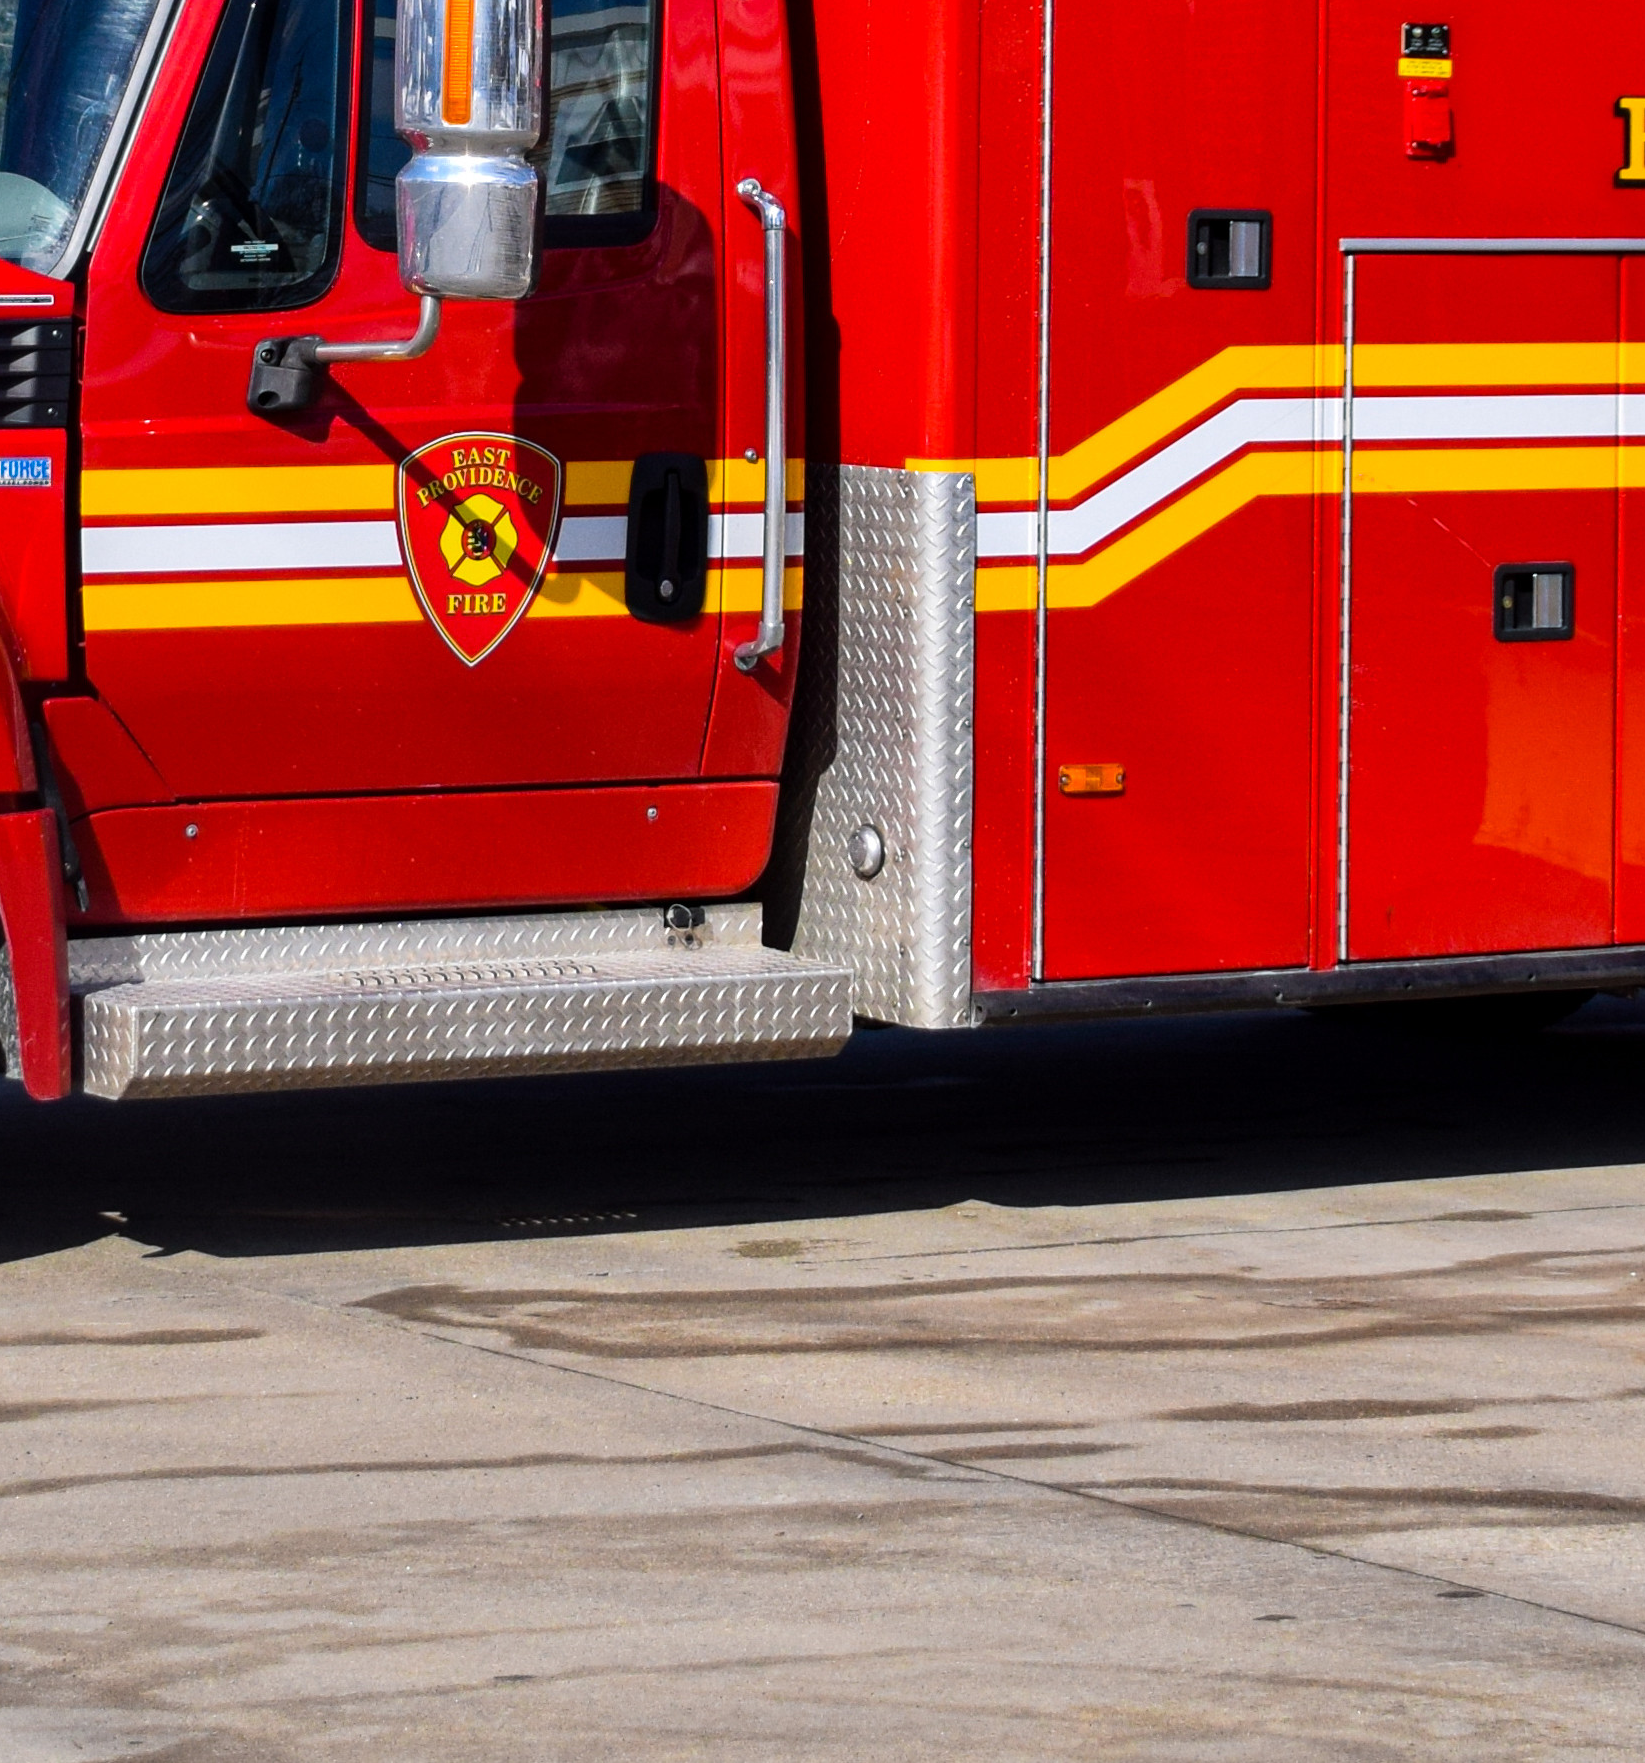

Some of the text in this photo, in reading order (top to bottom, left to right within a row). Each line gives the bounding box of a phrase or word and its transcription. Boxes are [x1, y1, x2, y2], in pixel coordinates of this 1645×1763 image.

[451, 446, 511, 468] EAST
[416, 467, 543, 509] PROVIDENCE
[447, 592, 507, 616] FIRE
